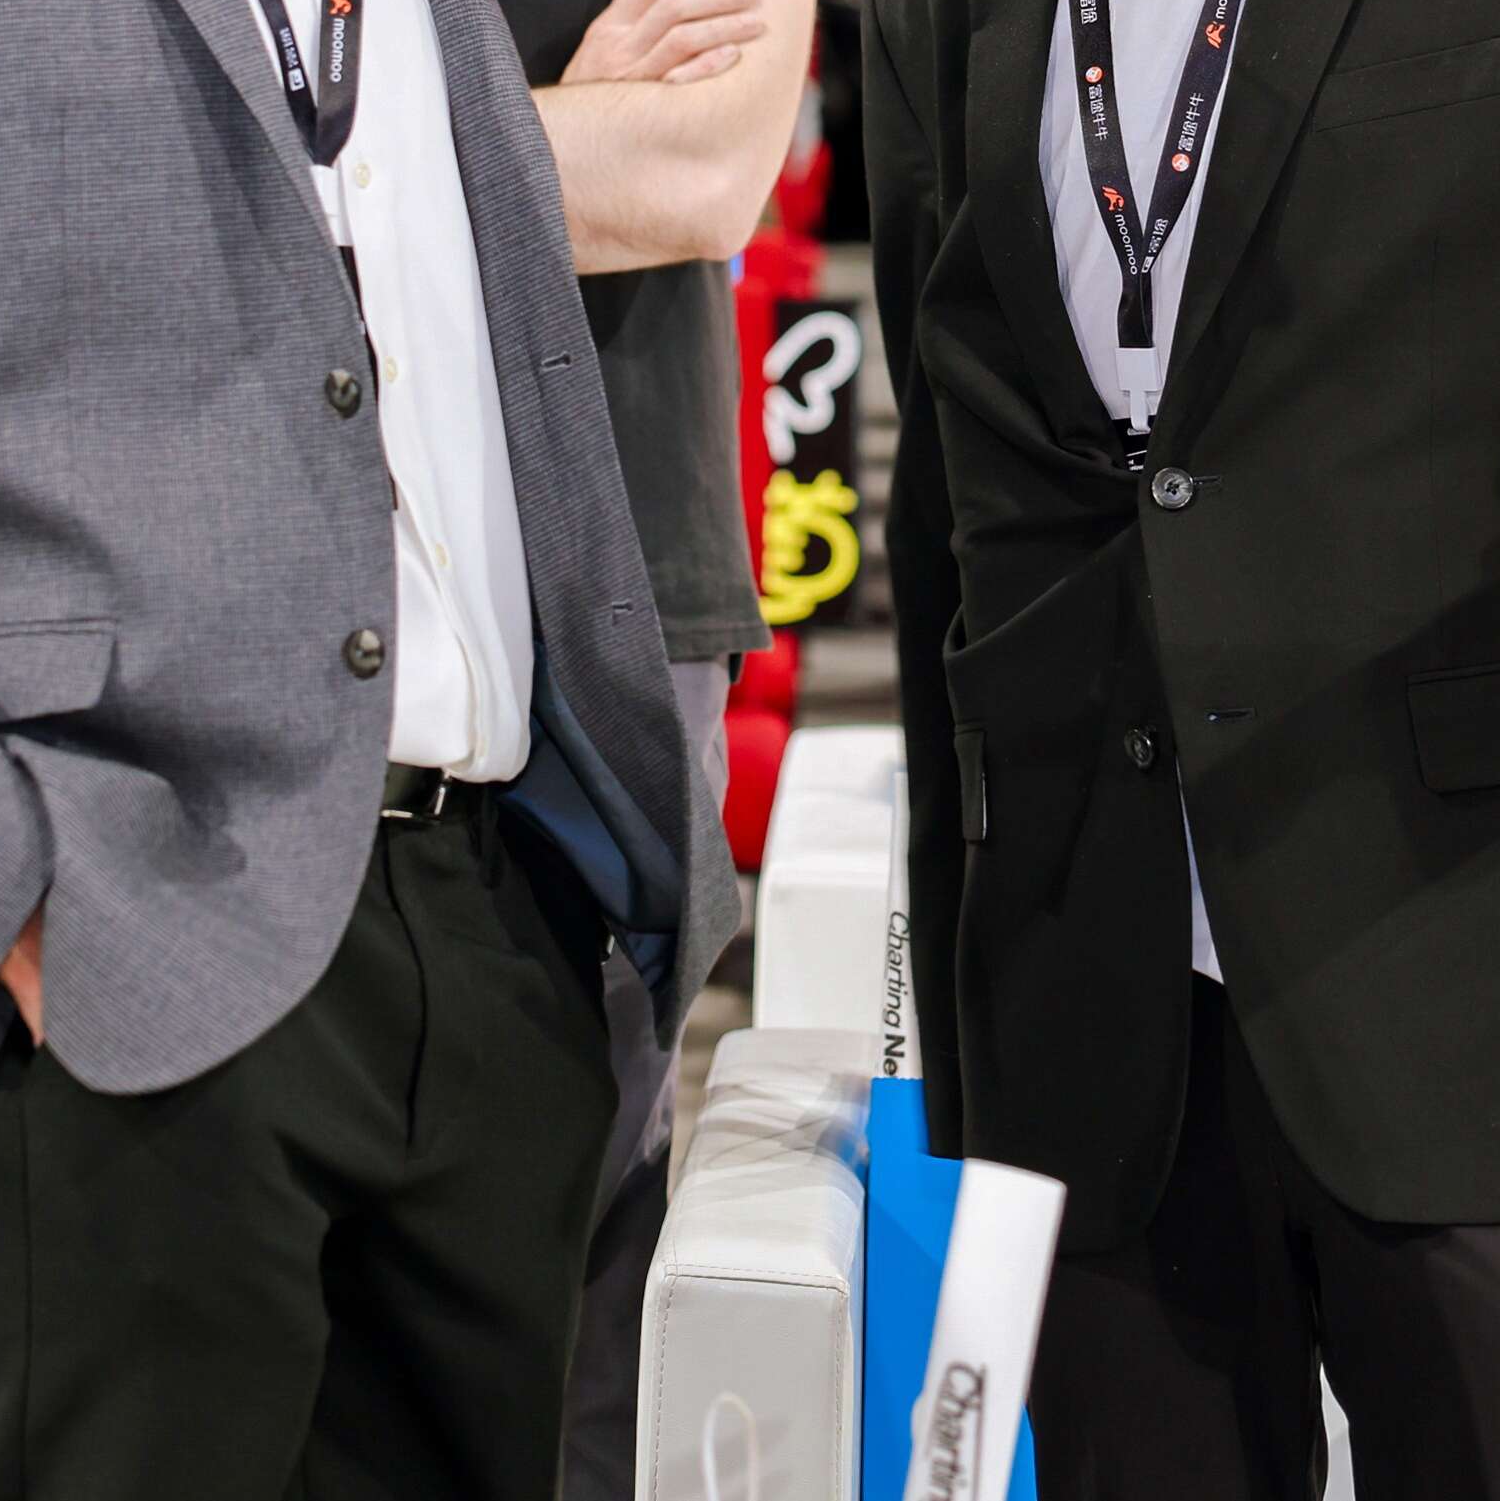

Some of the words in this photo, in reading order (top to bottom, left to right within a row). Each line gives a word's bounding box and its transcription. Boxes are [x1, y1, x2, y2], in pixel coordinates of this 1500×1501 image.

[329, 17, 347, 83] moomoo
[1085, 83, 1108, 141] 富途牛牛
[1178, 92, 1203, 153] 富途牛牛
[1113, 212, 1138, 277] moomoo
[1149, 217, 1170, 254] 富途
[881, 910, 910, 1029] Charting
[882, 1033, 907, 1077] Ne
